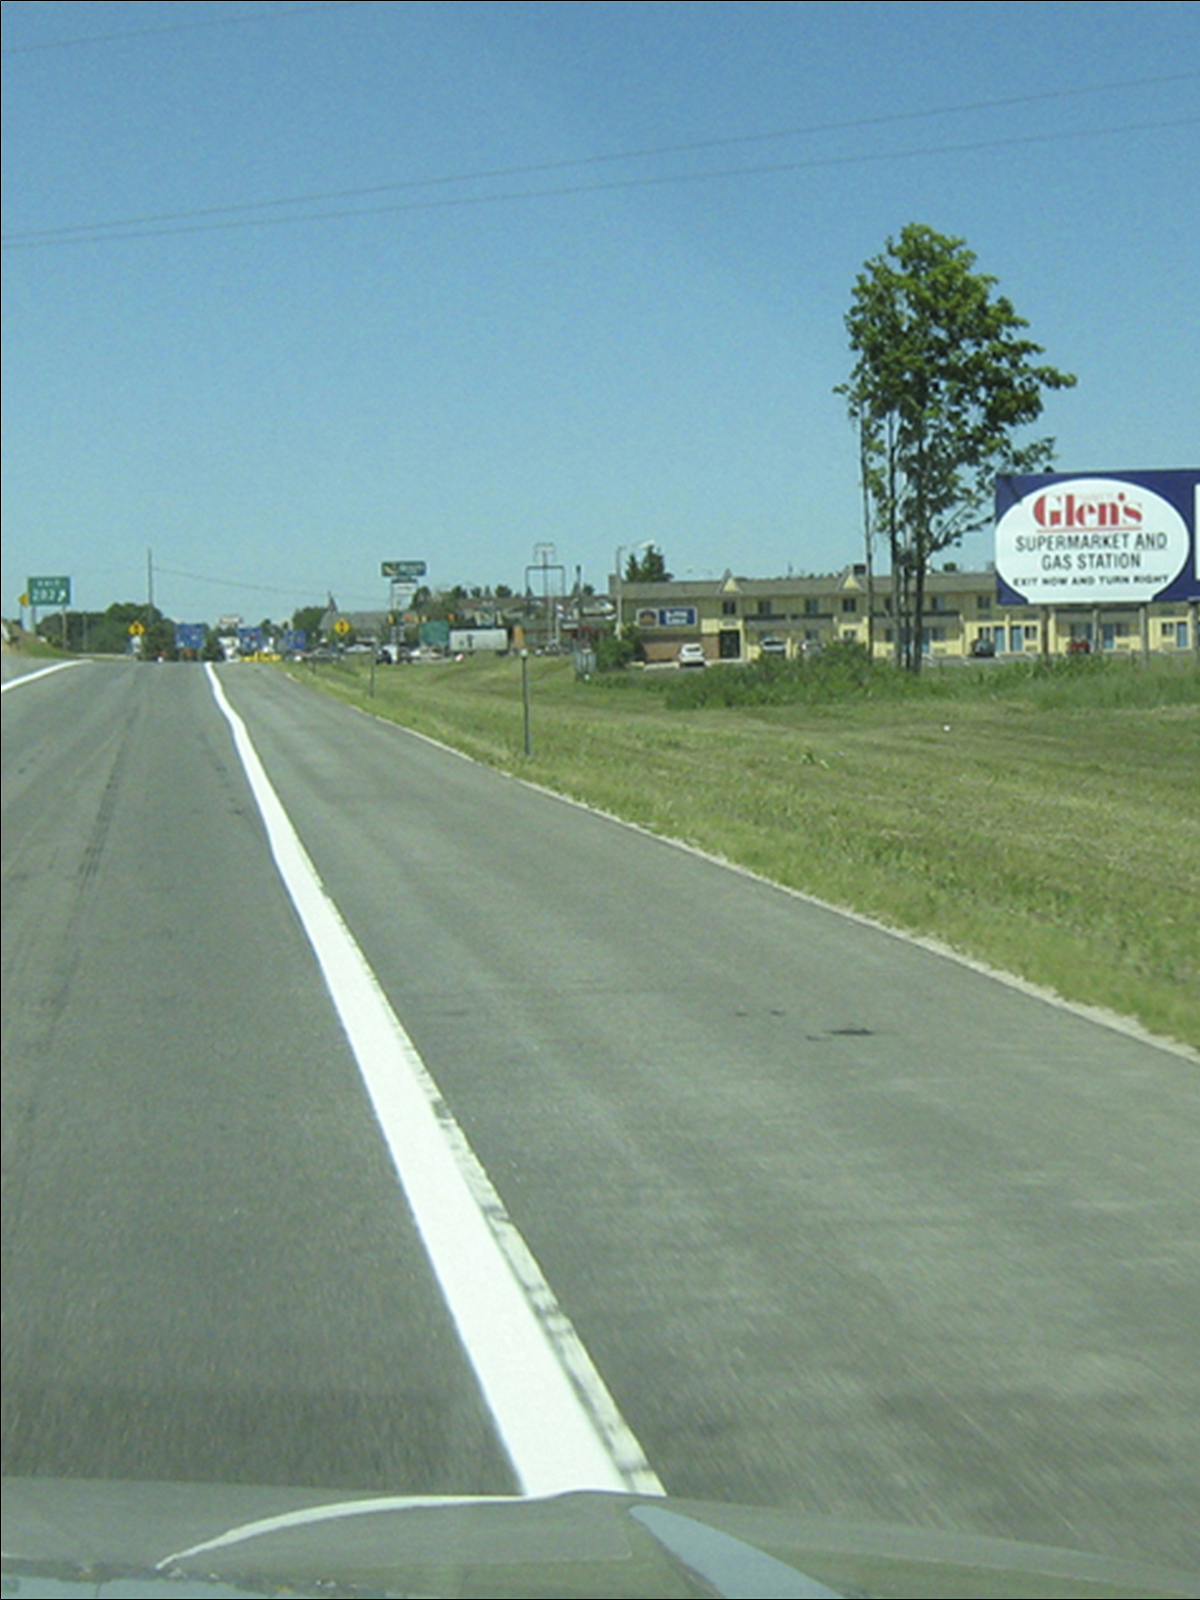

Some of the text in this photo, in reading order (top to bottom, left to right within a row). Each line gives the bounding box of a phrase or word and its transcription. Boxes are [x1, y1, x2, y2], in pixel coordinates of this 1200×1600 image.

[1033, 492, 1143, 528] Glen's
[1015, 532, 1168, 552] SUPERMARKET AND
[1041, 552, 1142, 571] GAS STATION
[1013, 574, 1170, 587] EXIT NOW AND TURN RIGHT
